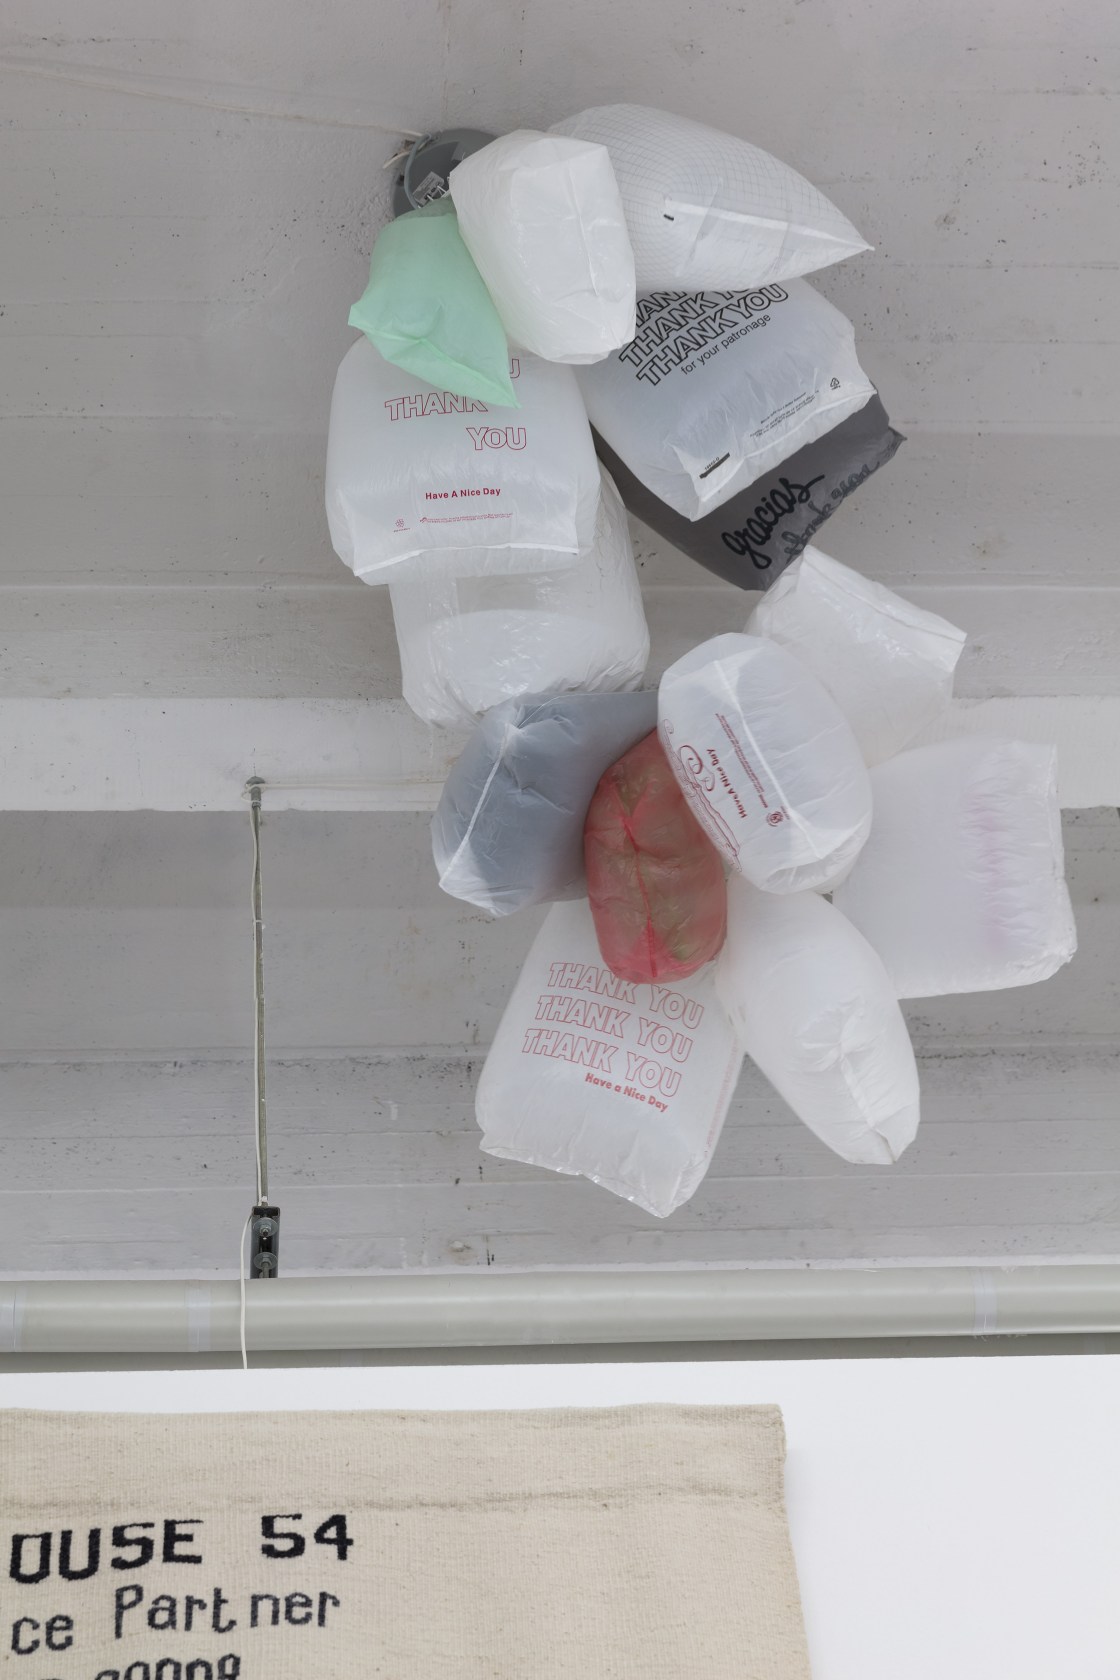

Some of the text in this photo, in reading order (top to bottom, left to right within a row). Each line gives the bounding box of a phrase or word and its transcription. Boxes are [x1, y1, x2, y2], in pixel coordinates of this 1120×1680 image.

[618, 291, 721, 368] THANK
[636, 307, 740, 386] THANK
[723, 283, 789, 320] YOU
[680, 314, 771, 375] for your patronage
[384, 391, 489, 421] THANK
[466, 426, 527, 451] YOU
[425, 486, 502, 501] Have A Nice Day
[721, 473, 826, 570] gracias
[706, 748, 748, 819] Have A Nice Day
[535, 995, 694, 1063] THANK YOU
[548, 962, 705, 1030] THANK YOU
[521, 1028, 682, 1098] THANK YOU
[585, 1072, 669, 1114] Have a Nice Day
[261, 1512, 354, 1561] 54
[11, 1583, 341, 1656] ce Partner
